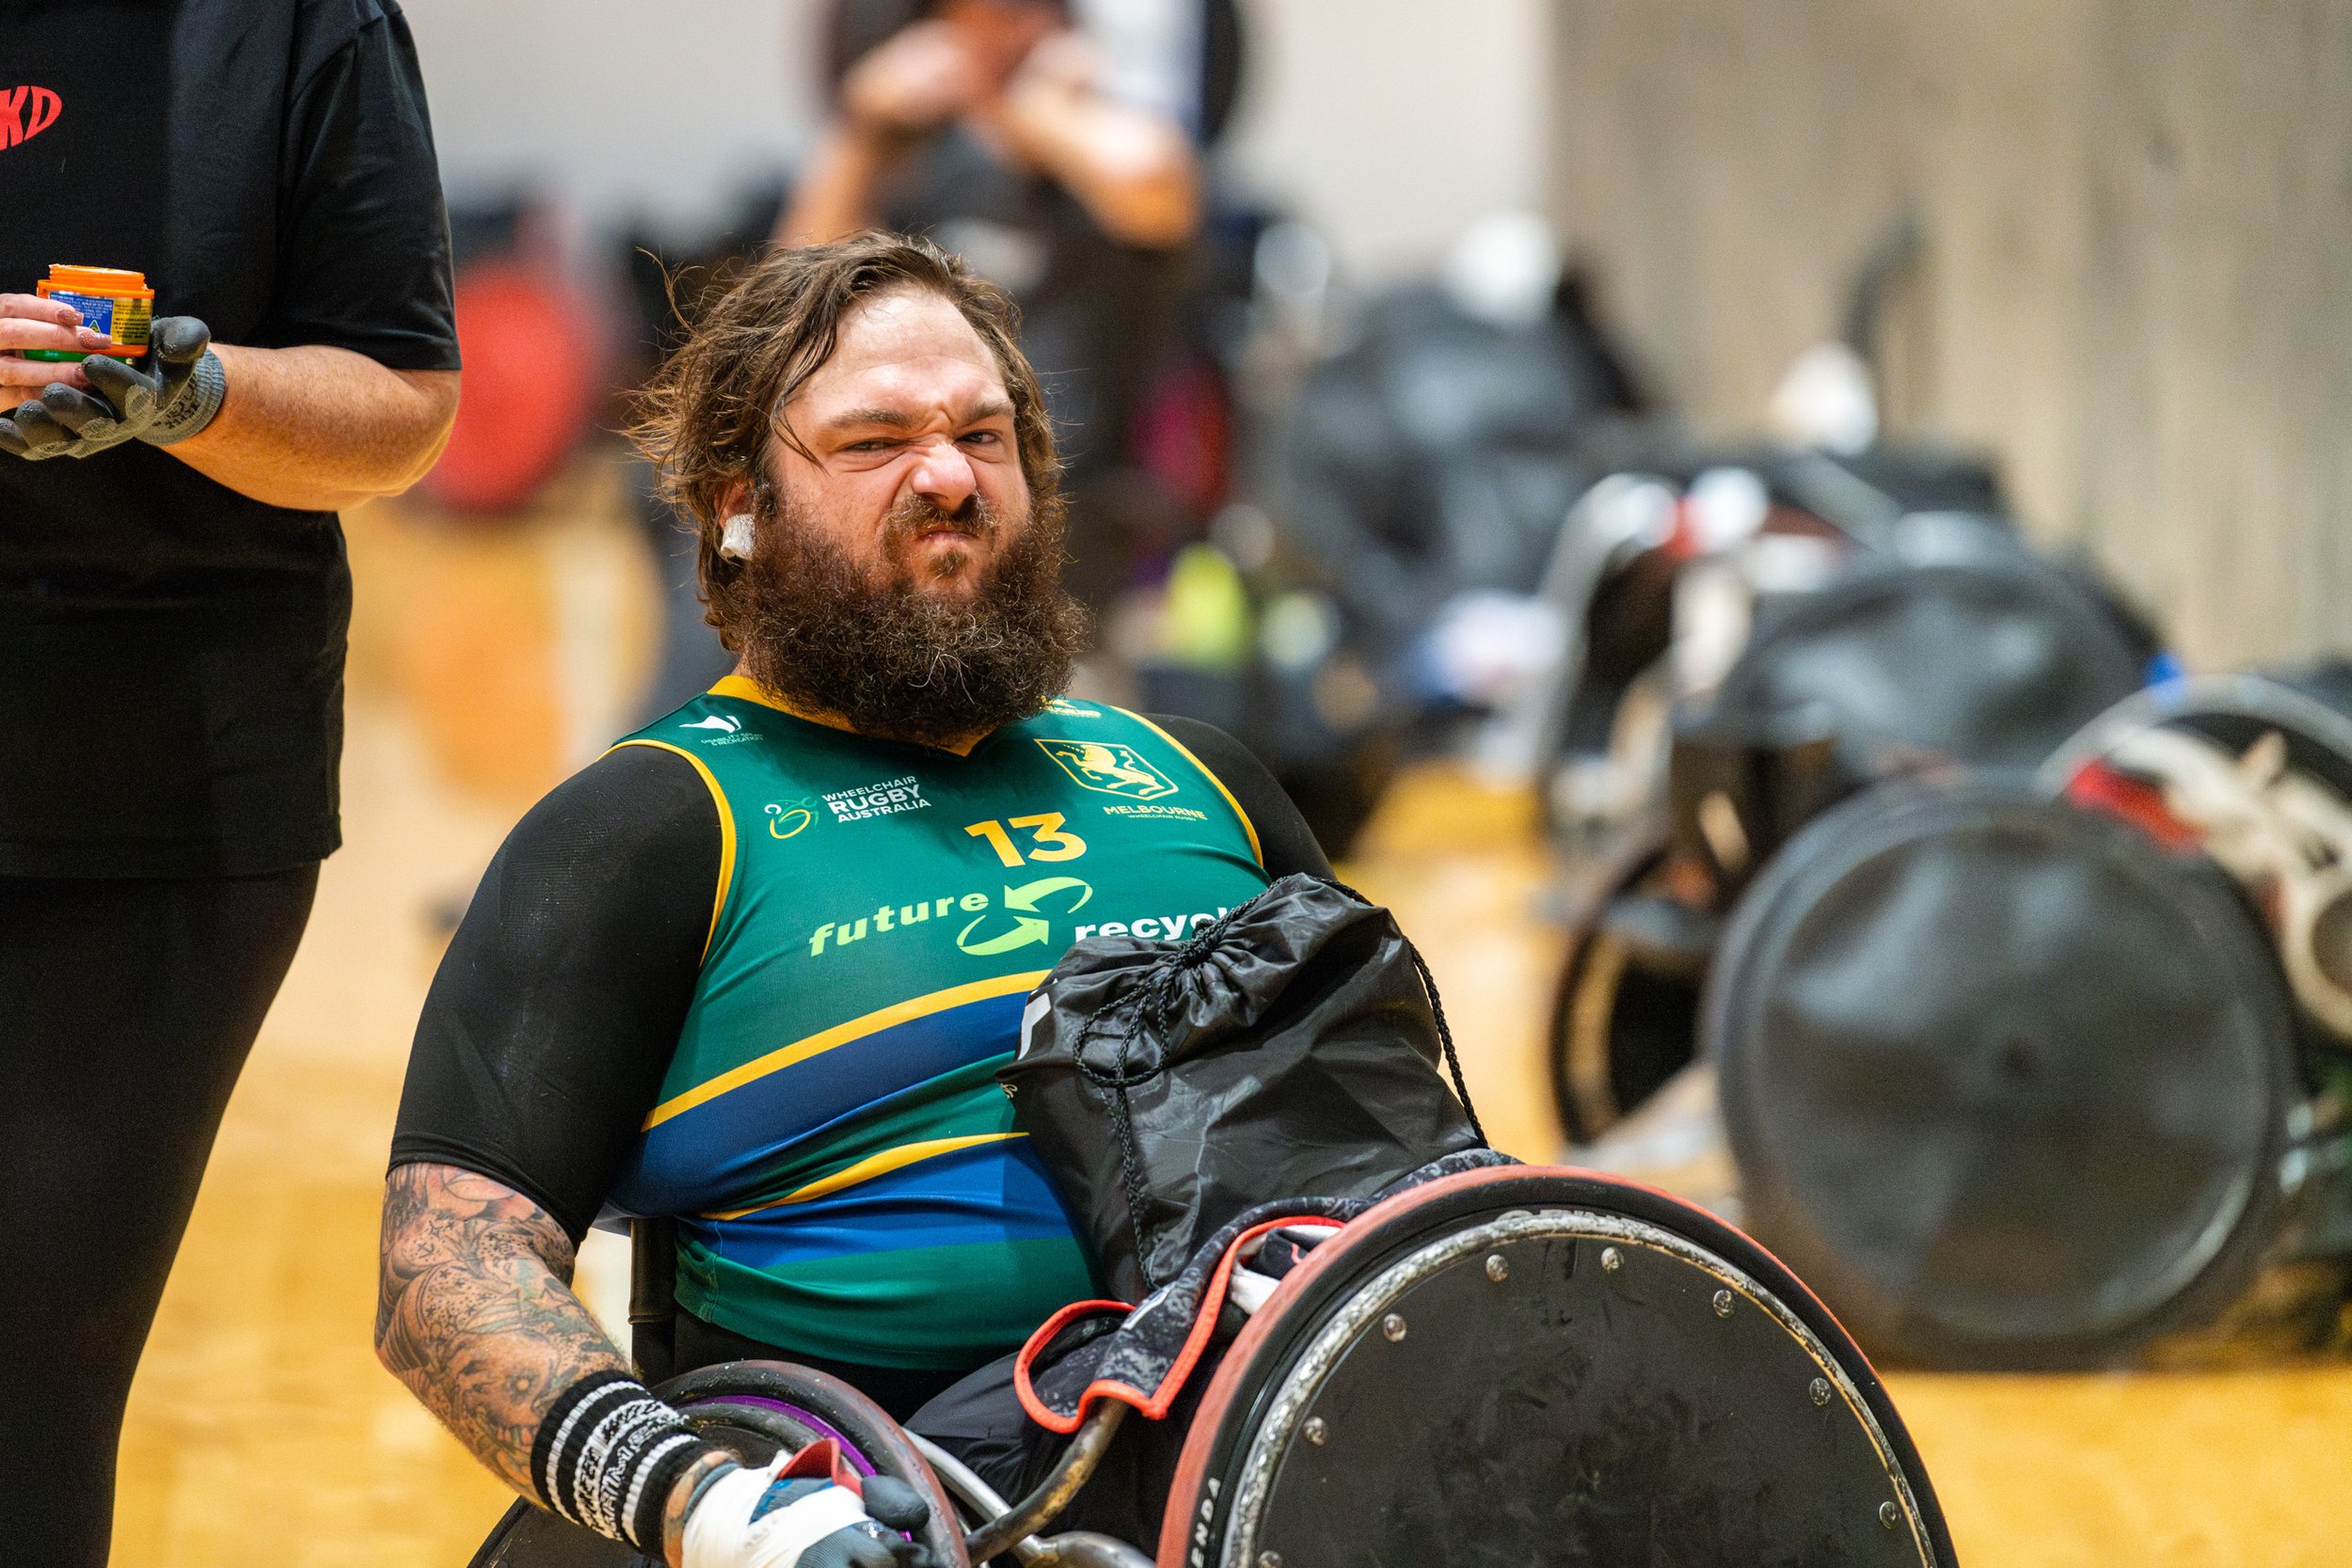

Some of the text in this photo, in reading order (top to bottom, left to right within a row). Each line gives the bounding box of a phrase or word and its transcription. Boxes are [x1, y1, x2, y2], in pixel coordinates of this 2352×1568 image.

[821, 775, 917, 802] WHEELCHAIR
[828, 784, 921, 815] RUGBY
[837, 799, 932, 824] AUSTRALIA
[1103, 805, 1208, 820] MELBOURNE
[963, 812, 1088, 868] 13
[808, 892, 990, 958] future
